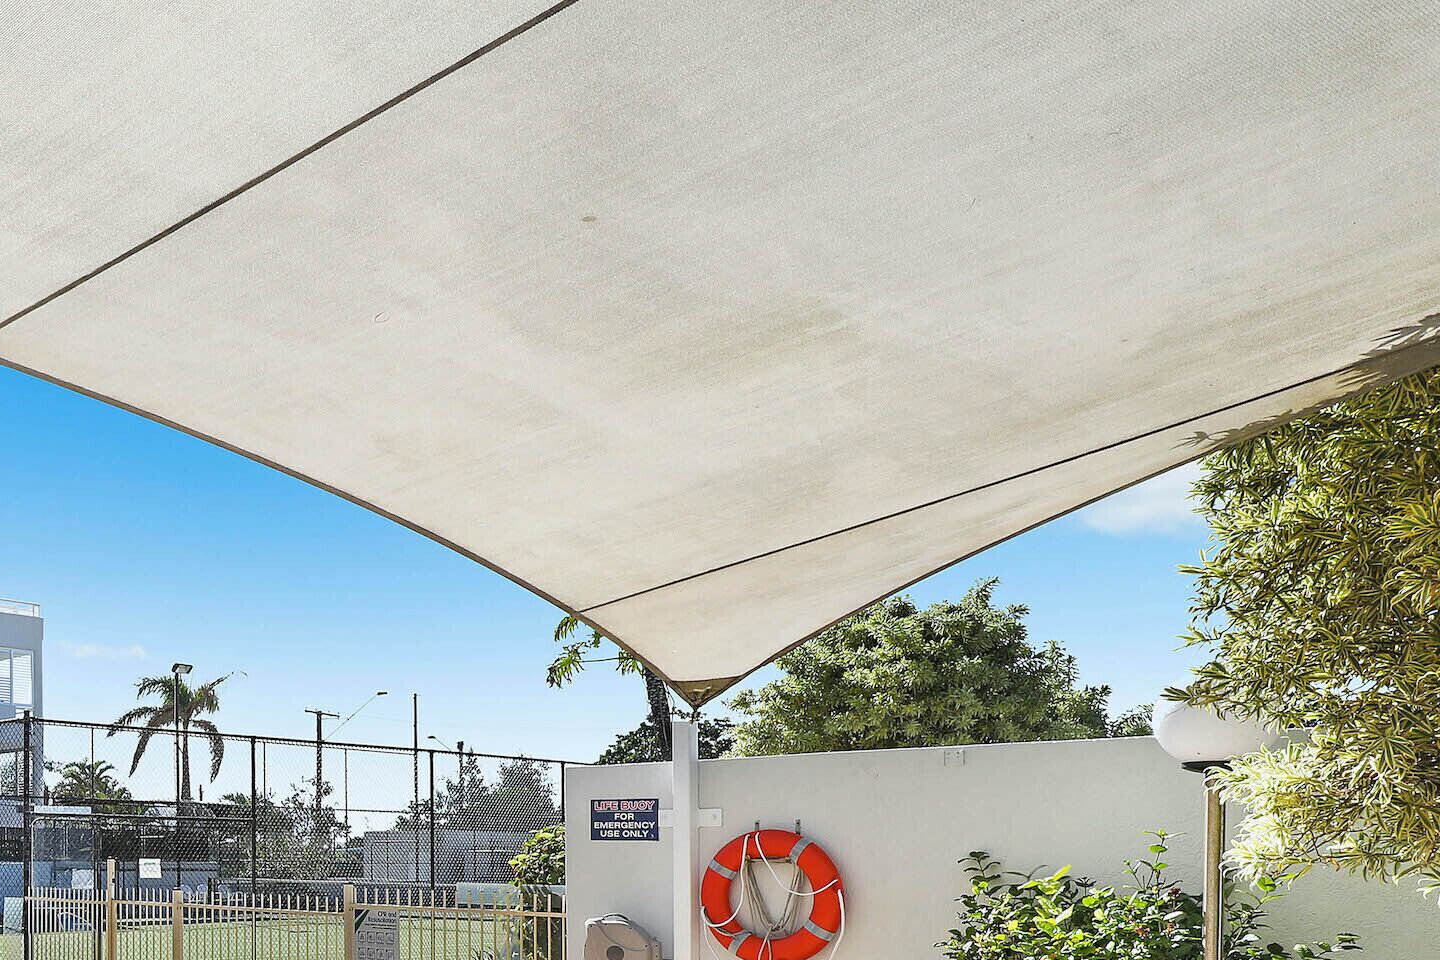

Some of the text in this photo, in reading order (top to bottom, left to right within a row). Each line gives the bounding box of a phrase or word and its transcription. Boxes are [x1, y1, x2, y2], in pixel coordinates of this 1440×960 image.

[594, 800, 655, 811] LIFE BUOY
[614, 812, 634, 820] FOR
[600, 829, 649, 838] USE ONLY
